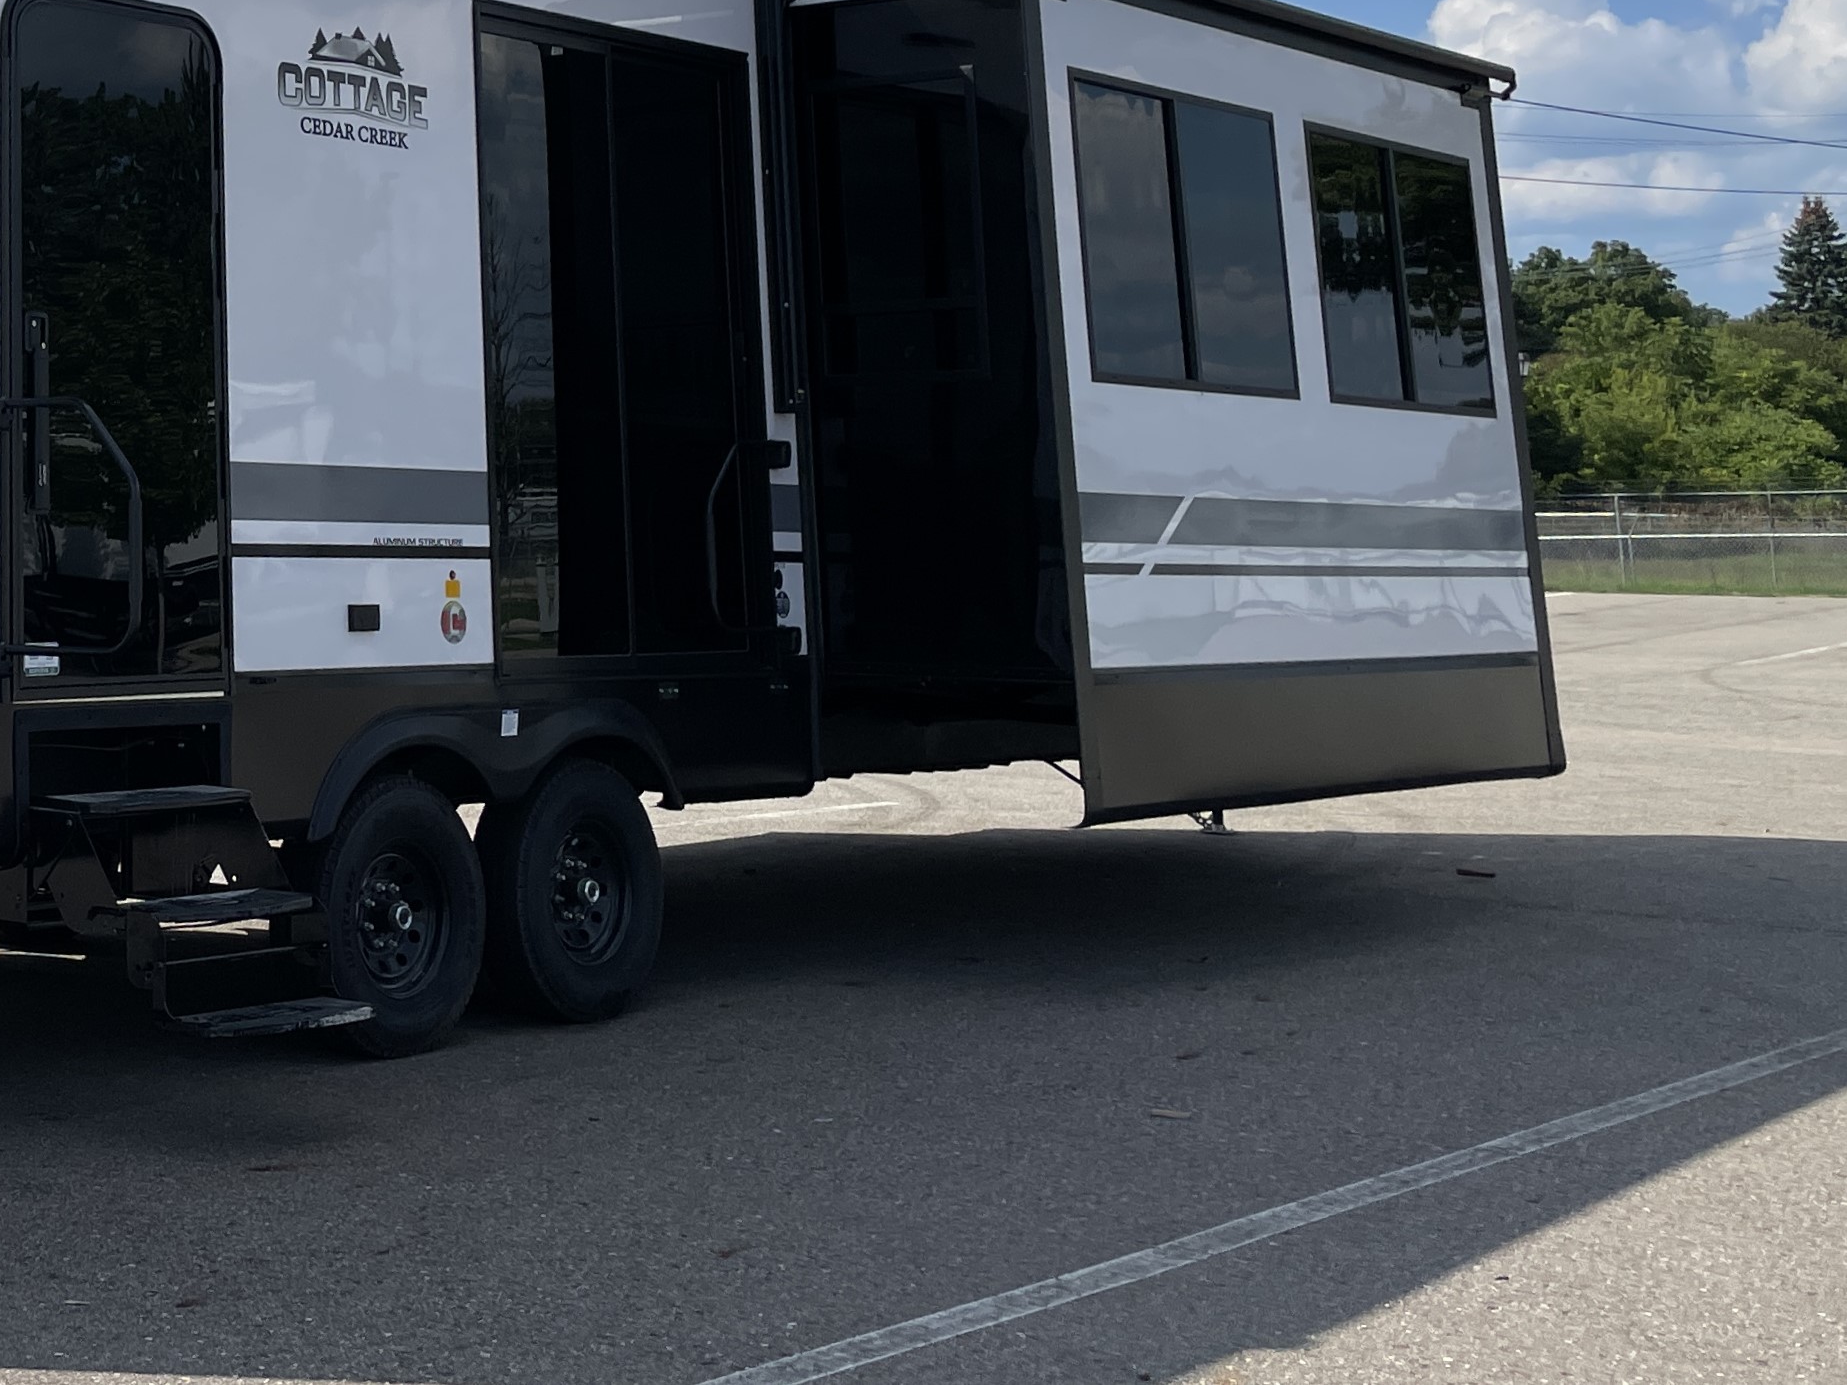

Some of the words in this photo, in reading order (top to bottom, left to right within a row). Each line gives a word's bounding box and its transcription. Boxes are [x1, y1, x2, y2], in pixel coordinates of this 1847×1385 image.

[277, 61, 429, 130] COTTAGE
[300, 116, 356, 142] CEDAR
[357, 125, 409, 150] CREEK
[372, 537, 417, 546] ALUMINUM
[418, 537, 464, 547] STRUCTURE
